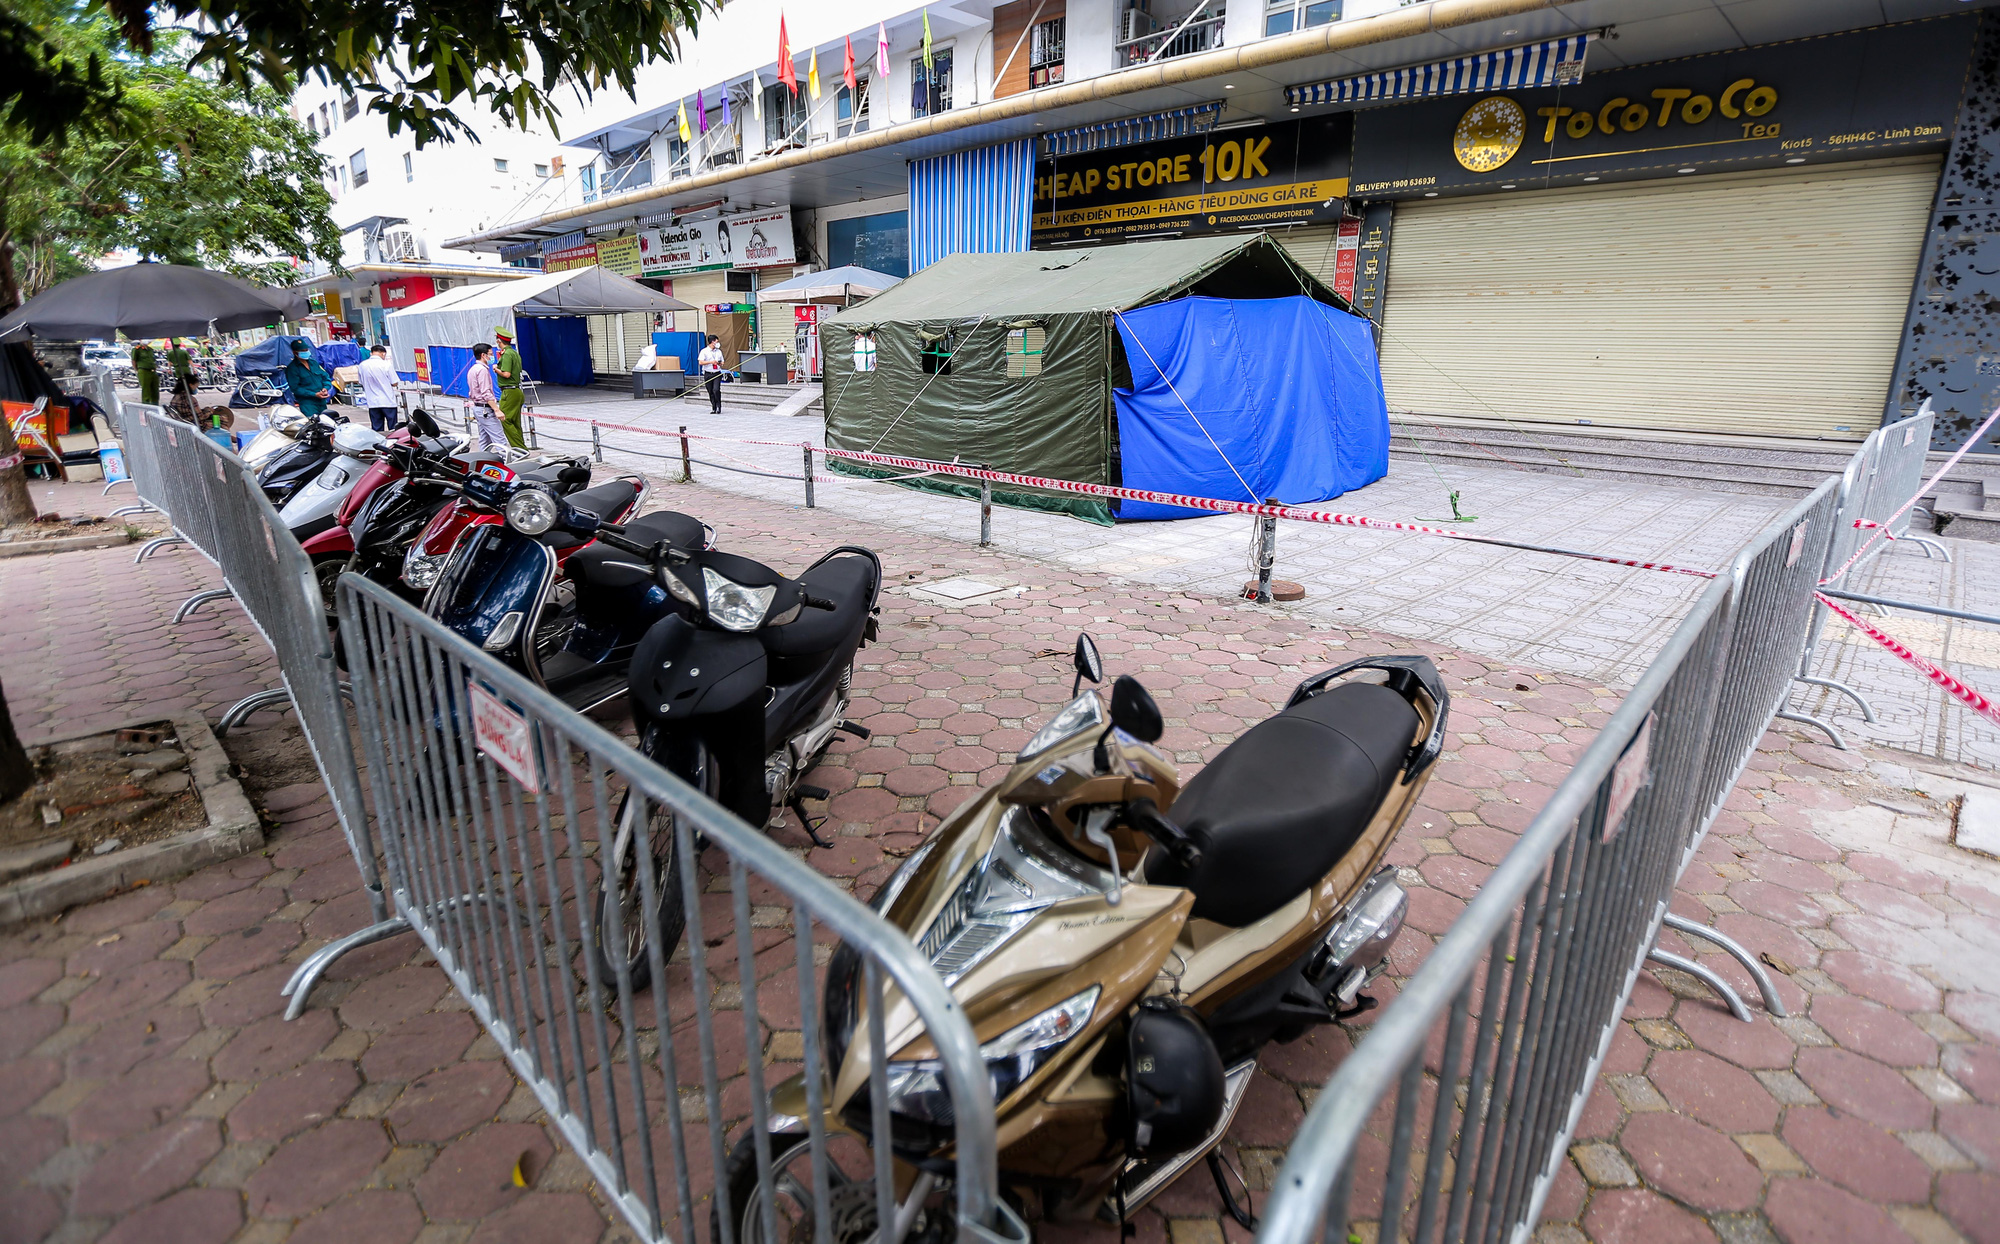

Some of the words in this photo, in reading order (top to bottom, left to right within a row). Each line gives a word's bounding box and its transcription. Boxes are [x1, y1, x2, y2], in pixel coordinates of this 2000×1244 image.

[1537, 78, 1778, 143] ToCoToCo
[1741, 122, 1781, 139] Tea
[1780, 138, 1813, 151] Kiot5
[1828, 131, 1876, 145] 56HH4C
[1106, 154, 1192, 191] STORE
[1199, 135, 1272, 184] 10K
[1392, 179, 1408, 188] 1900
[1409, 176, 1436, 186] 636936
[1040, 215, 1060, 226] PHỤ
[1062, 211, 1085, 225] KIỆN
[1087, 208, 1112, 222] ĐIỆN
[1159, 200, 1195, 213] HÀNG
[1199, 195, 1226, 209] TIÊU
[1229, 191, 1269, 206] DÙNG
[1272, 186, 1297, 201] GIÁ
[1299, 184, 1318, 199] RẺ
[1220, 208, 1314, 224] FACEBOOK.COM/CHEAPSTORE10K
[660, 230, 688, 244] Valencia
[690, 228, 702, 240] Glo
[489, 470, 500, 478] 12
[1093, 915, 1126, 926] Edition
